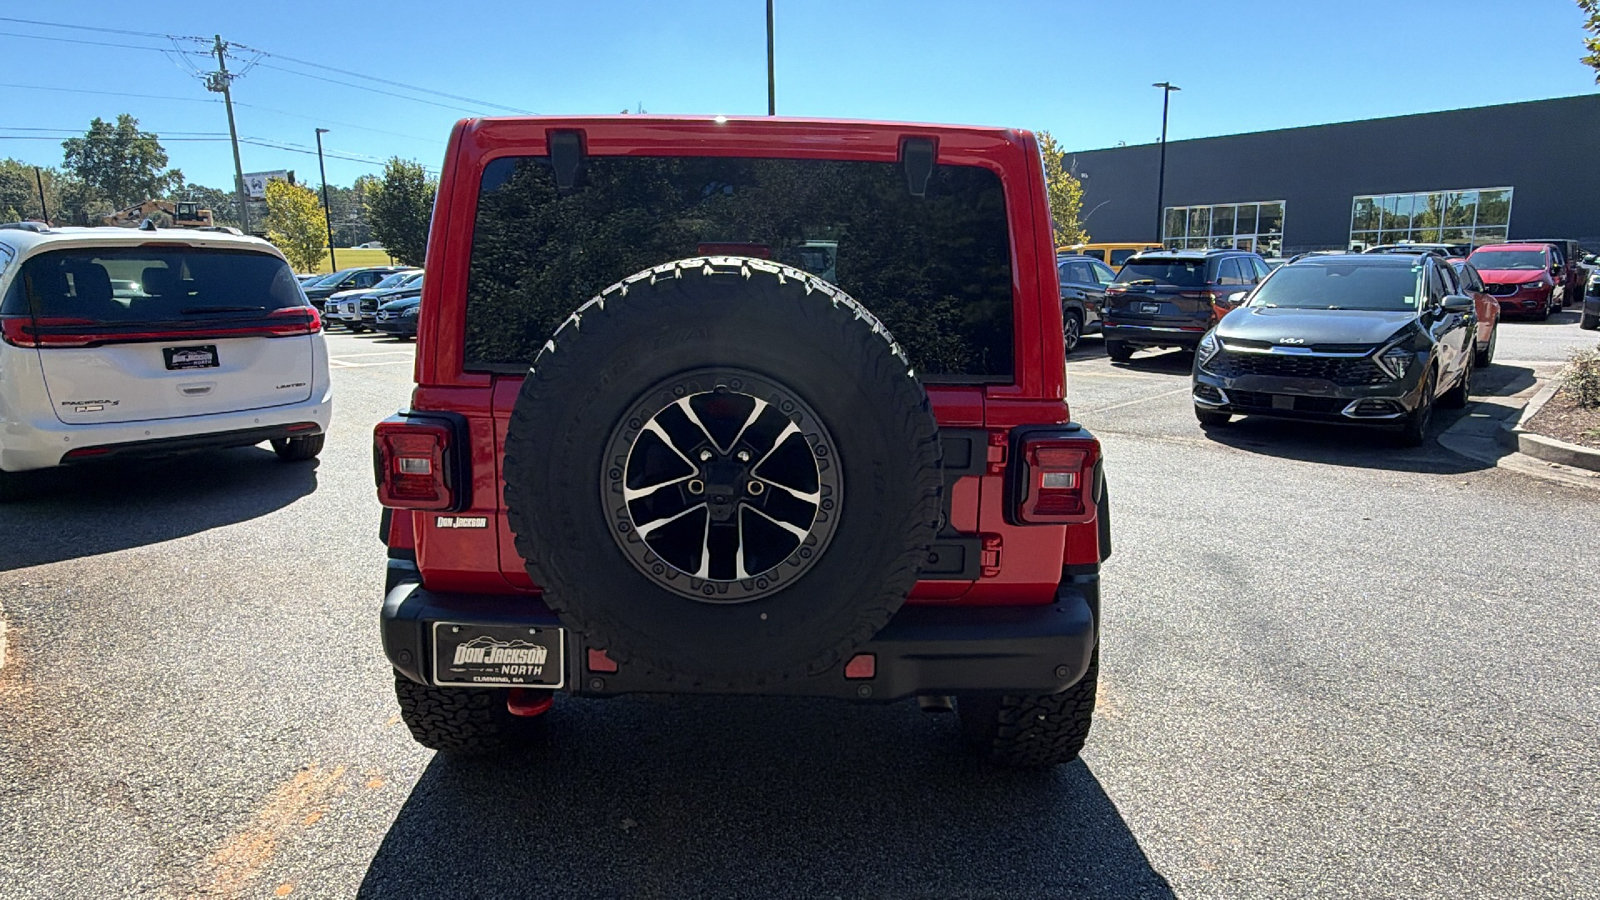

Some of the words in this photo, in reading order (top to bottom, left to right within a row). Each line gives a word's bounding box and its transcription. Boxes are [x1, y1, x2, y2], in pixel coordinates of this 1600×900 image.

[453, 646, 486, 665] DON
[484, 646, 548, 664] JACKSON
[501, 665, 542, 676] NORTH
